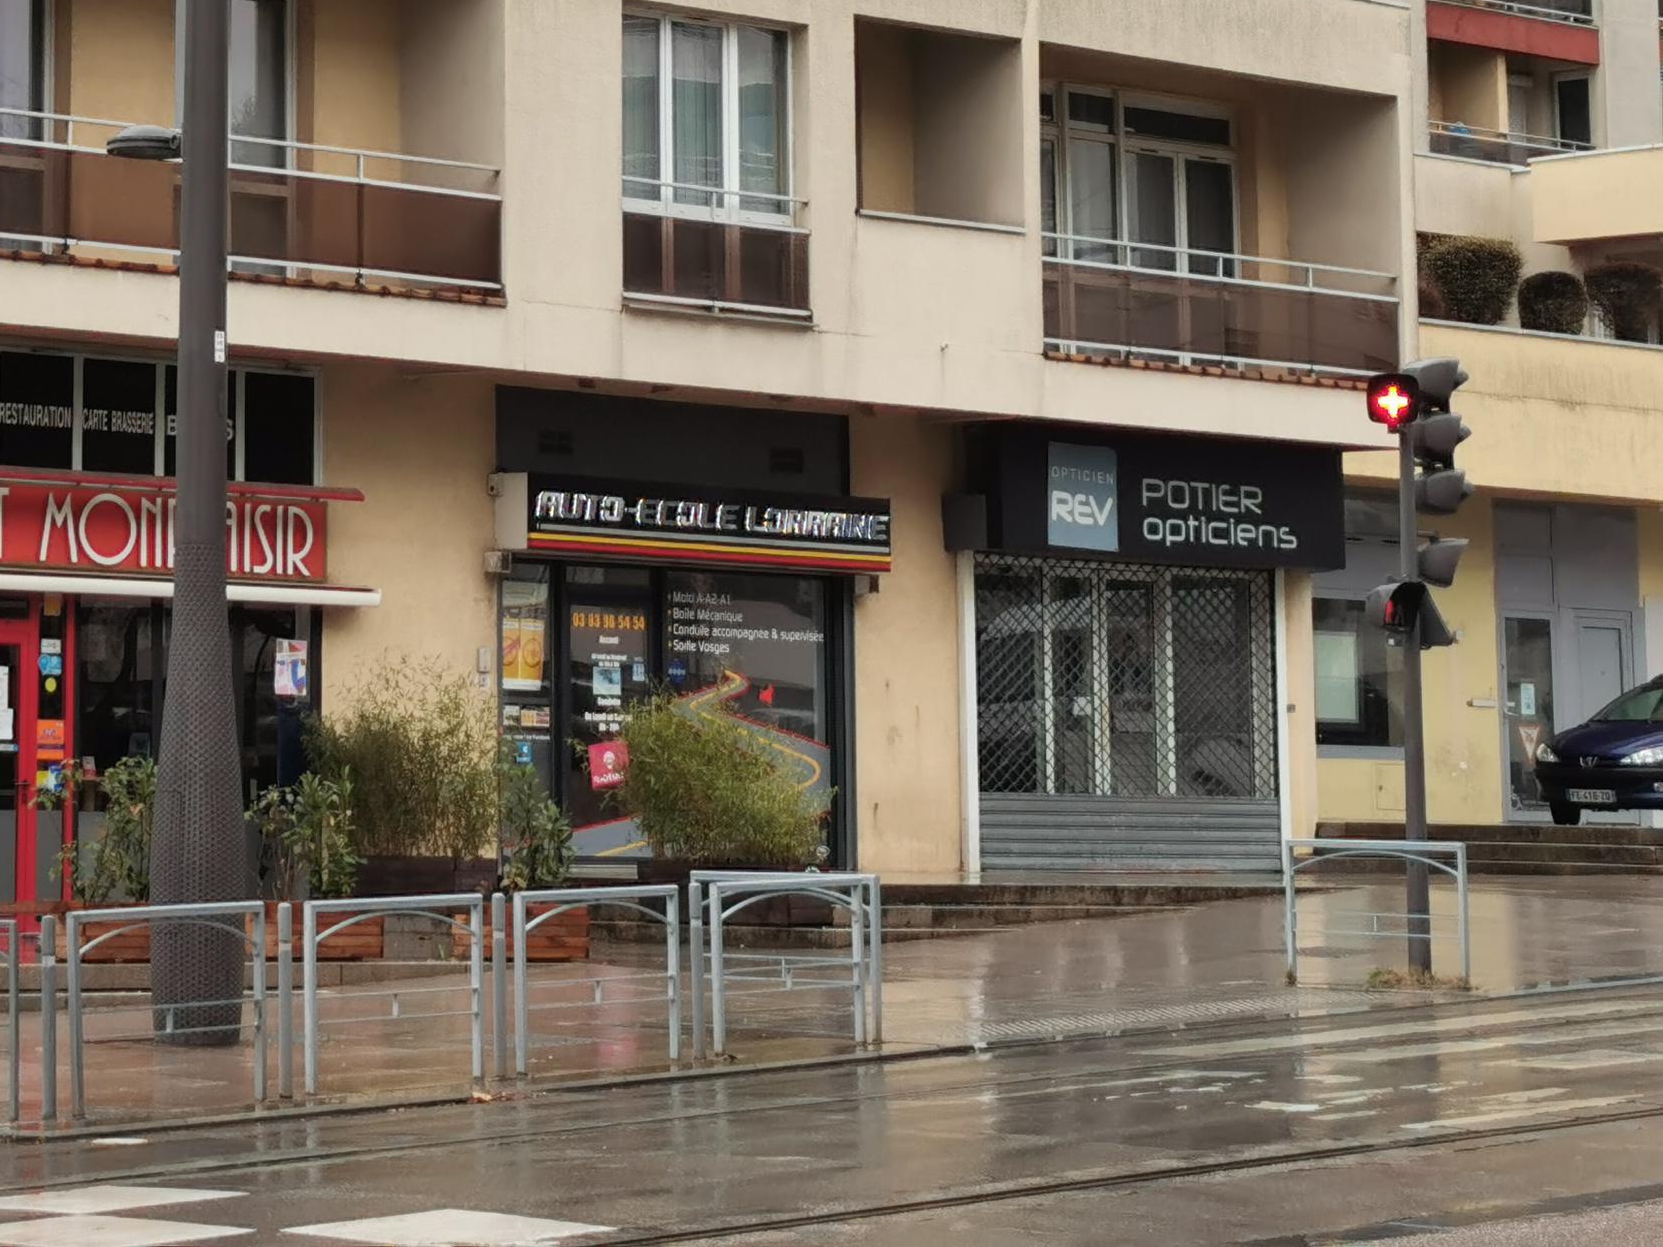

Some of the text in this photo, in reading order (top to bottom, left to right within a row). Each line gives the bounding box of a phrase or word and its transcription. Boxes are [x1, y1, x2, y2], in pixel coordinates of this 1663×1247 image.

[82, 407, 108, 432] CARTE
[111, 409, 154, 435] BRASSERIE
[1050, 465, 1114, 485] OPTICIEN
[1051, 490, 1114, 527] REV
[1142, 478, 1262, 515] POTIER
[537, 490, 890, 541] AUTO-ECOLE LORRAINE
[38, 491, 314, 578] MONAISIR
[1142, 515, 1298, 550] opticiens
[673, 591, 694, 604] Moto
[697, 609, 743, 624] Mécanique
[673, 623, 710, 637] Conduite
[771, 628, 778, 641] &
[698, 640, 730, 655] Vosges
